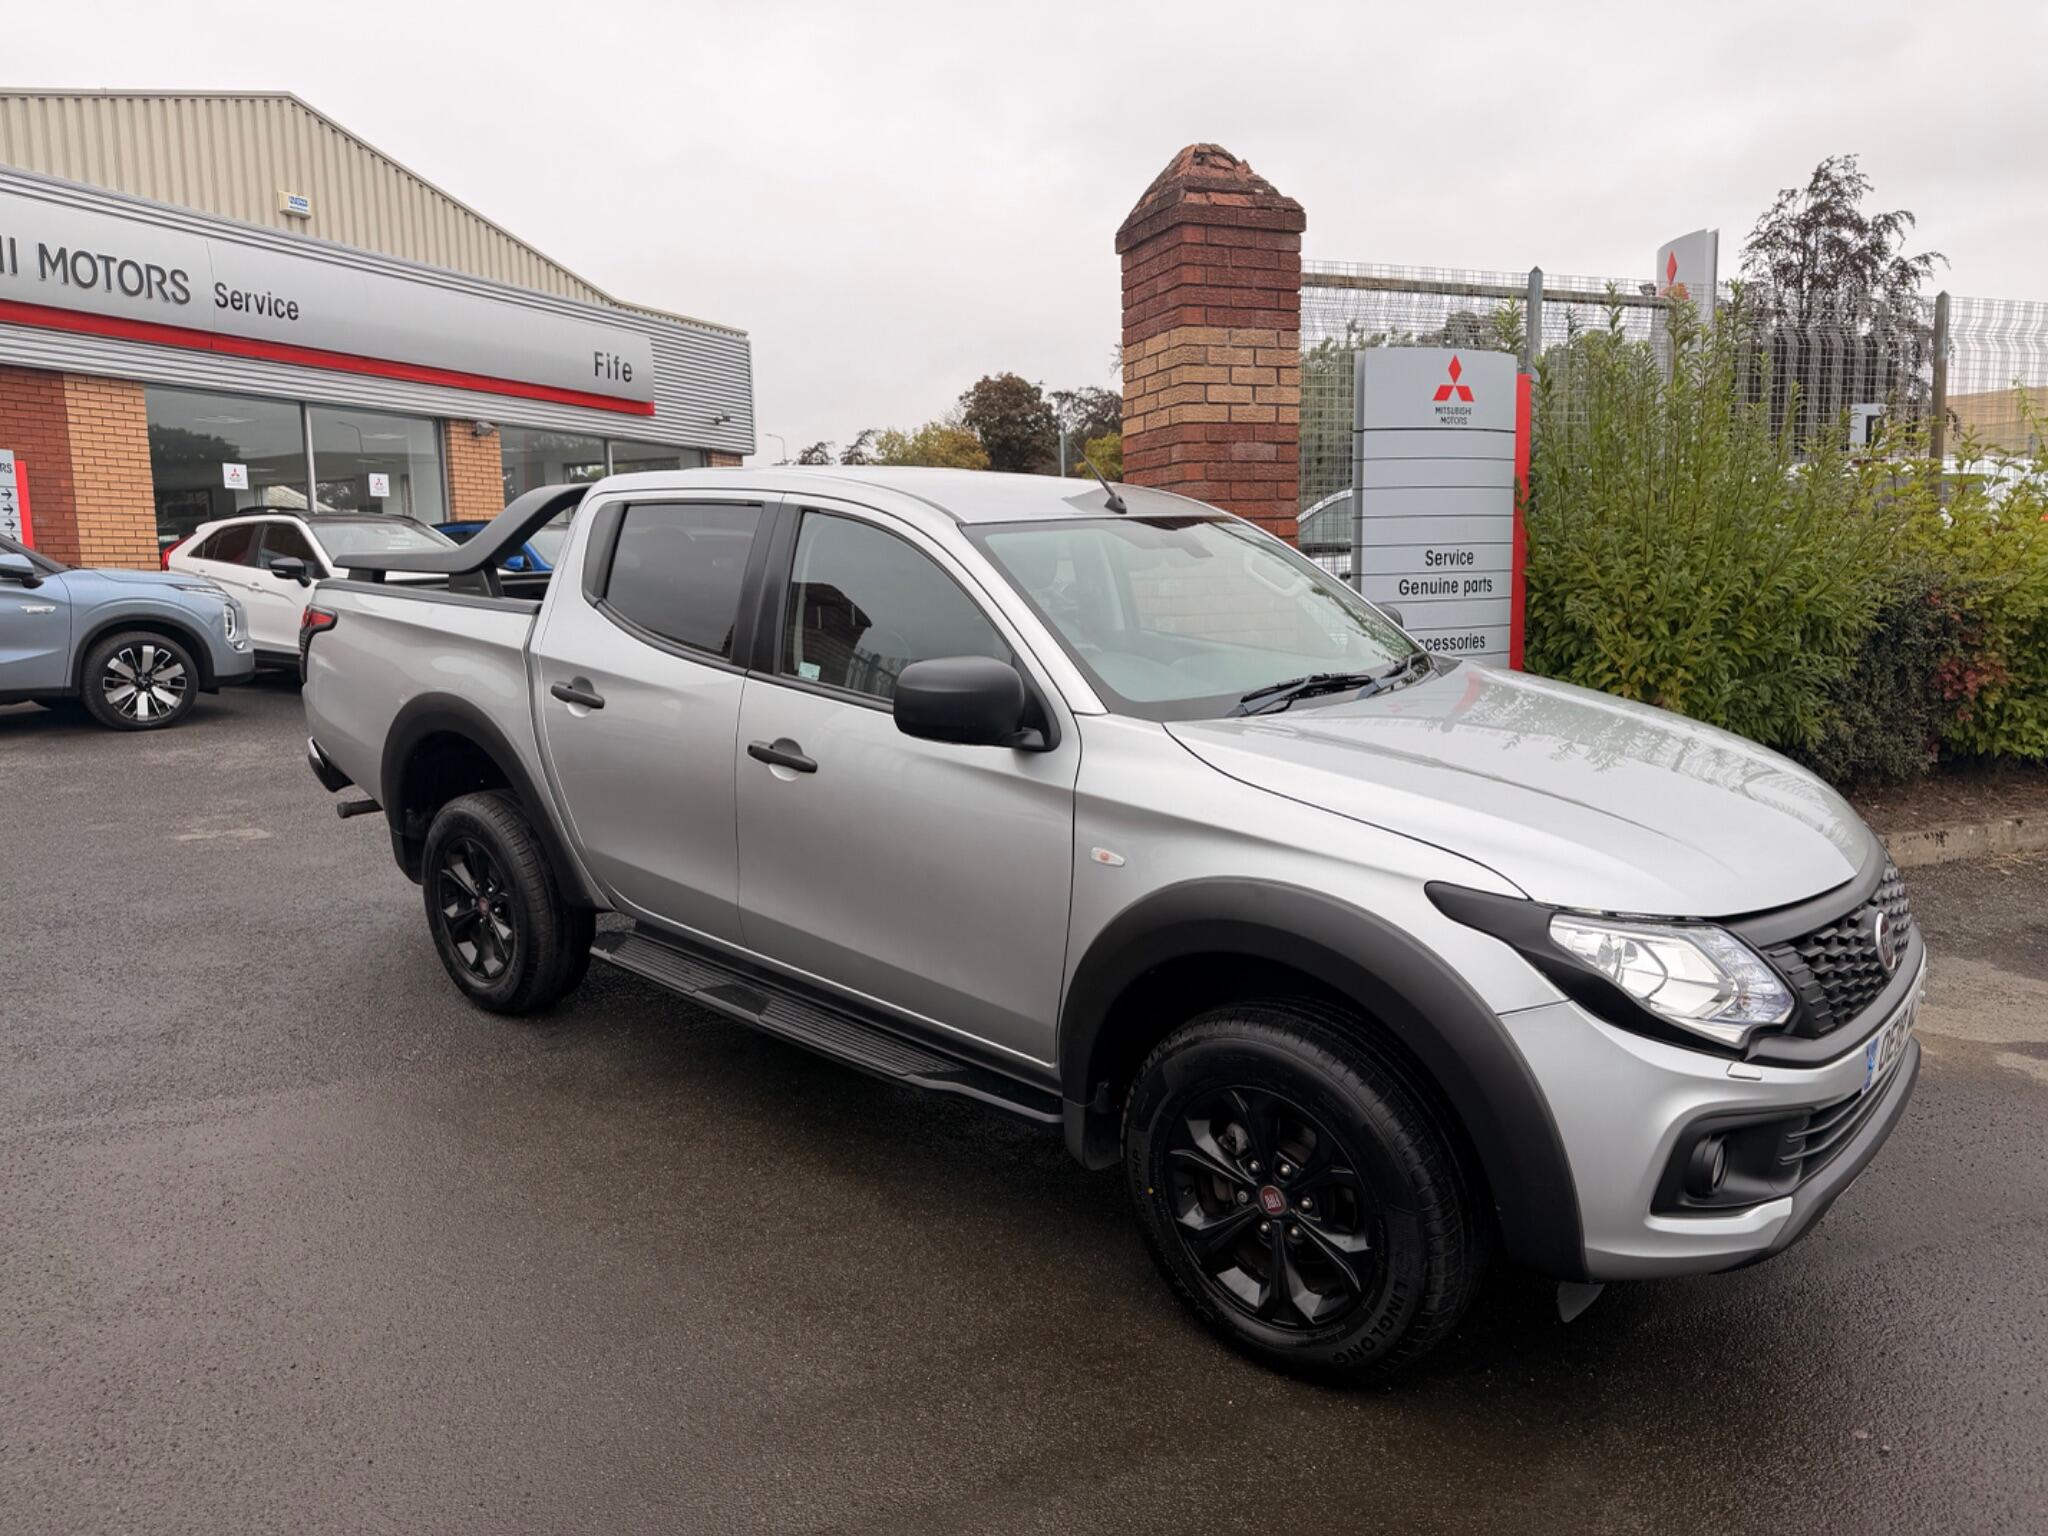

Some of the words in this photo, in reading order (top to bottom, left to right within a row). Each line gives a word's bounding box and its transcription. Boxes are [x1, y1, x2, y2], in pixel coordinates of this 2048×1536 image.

[38, 242, 191, 305] MOTORS
[214, 281, 299, 321] Service
[594, 351, 632, 382] Fife
[1435, 406, 1472, 415] MITSUBISHI
[1440, 416, 1468, 425] MOTORS
[1425, 549, 1474, 566] Service
[1399, 577, 1459, 595] Genuine
[1463, 576, 1493, 597] parts
[1333, 1280, 1408, 1368] LINGLONG
